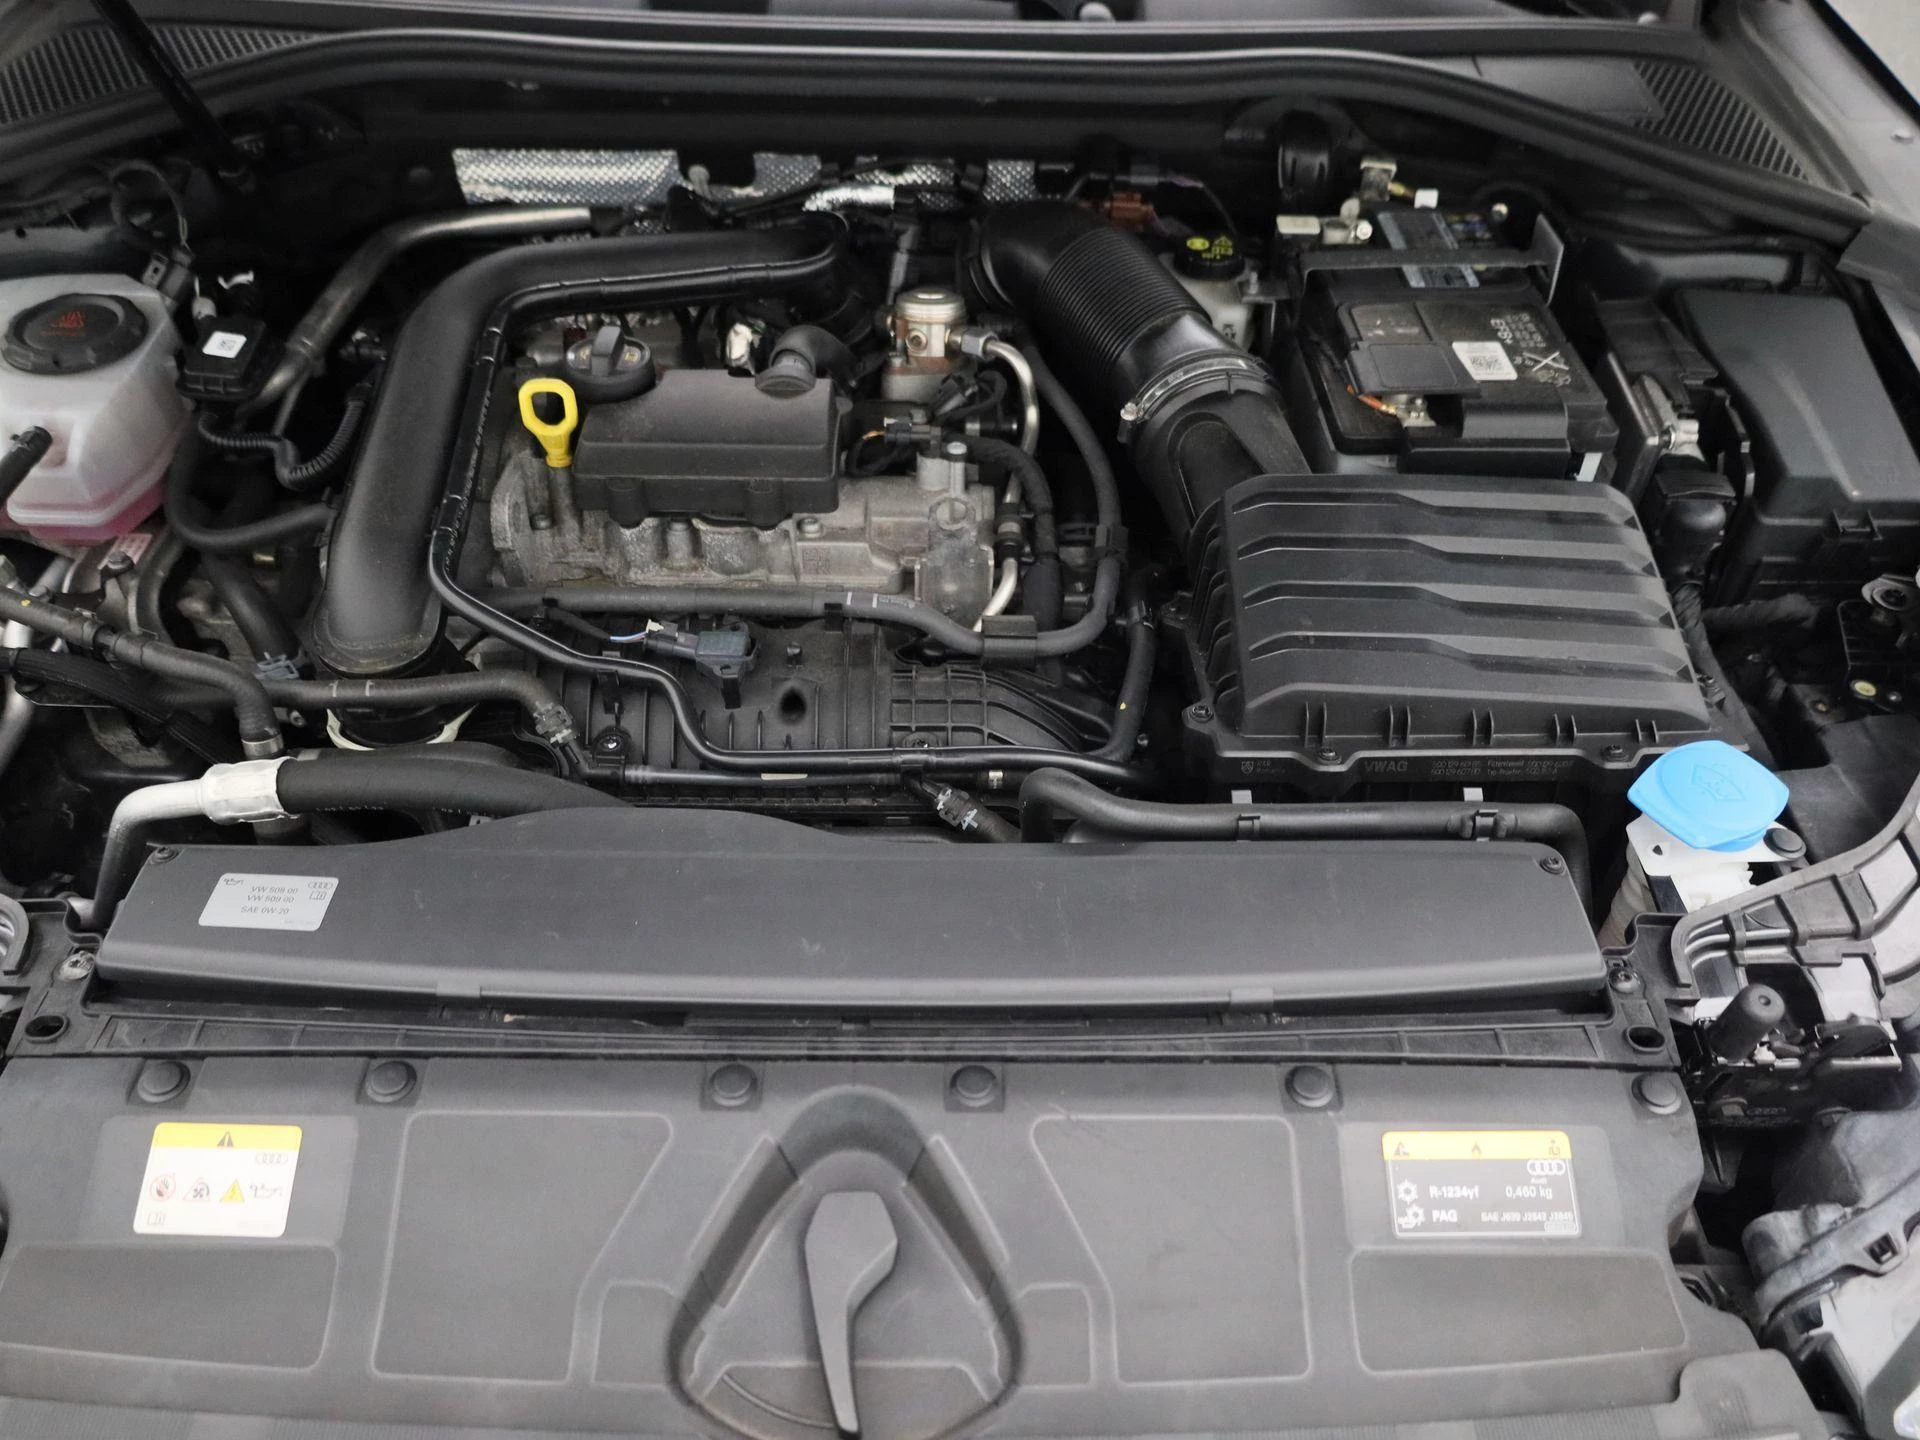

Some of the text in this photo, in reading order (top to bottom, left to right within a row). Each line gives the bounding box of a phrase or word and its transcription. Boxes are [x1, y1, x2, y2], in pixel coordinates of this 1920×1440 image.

[1364, 760, 1408, 773] VWAG
[1430, 1185, 1479, 1200] R-1234yf
[1538, 1183, 1553, 1200] kg
[1432, 1209, 1458, 1222] PAG
[1480, 1211, 1499, 1222] SAE
